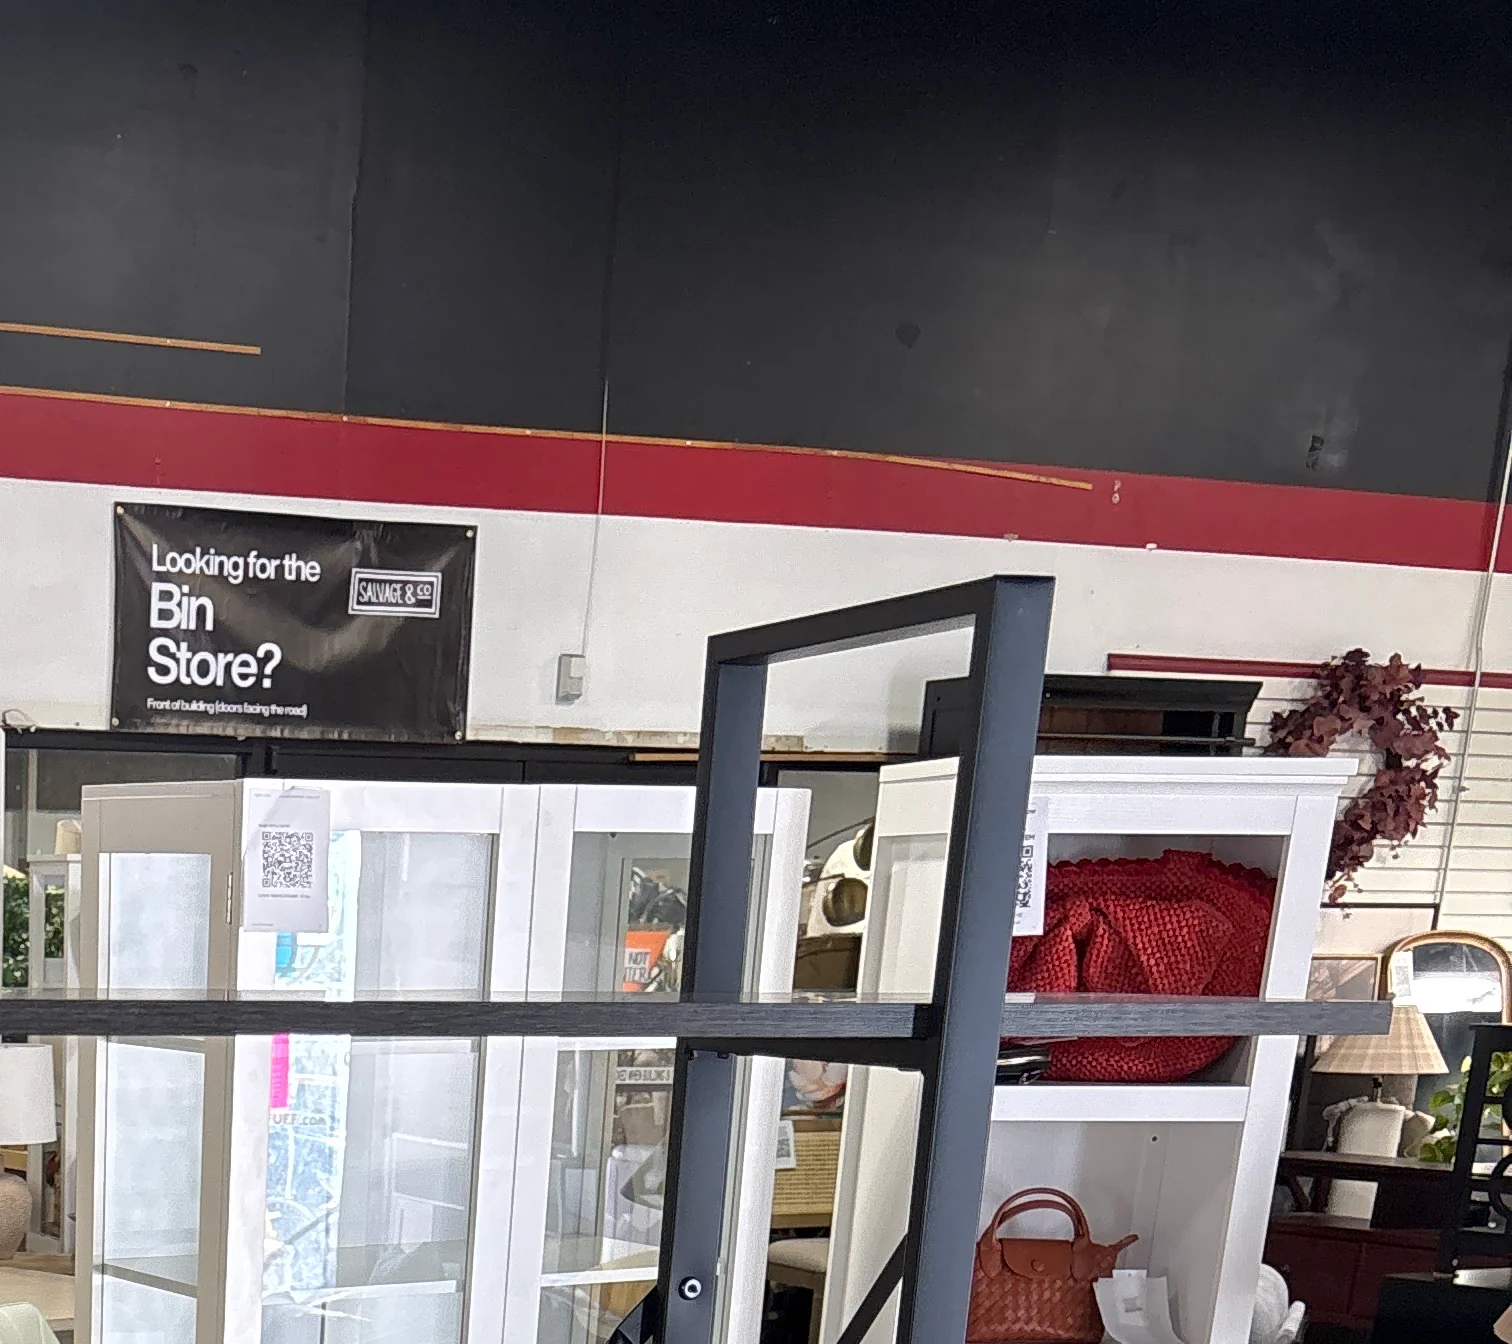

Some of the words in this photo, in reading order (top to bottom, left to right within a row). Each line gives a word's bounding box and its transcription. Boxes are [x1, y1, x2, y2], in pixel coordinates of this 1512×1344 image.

[152, 543, 244, 583] Looking
[247, 550, 282, 580] for
[283, 553, 321, 581] the
[149, 581, 214, 631] Bin
[358, 580, 402, 603] SALVAGE
[404, 584, 415, 604] &
[416, 584, 431, 598] CO
[147, 636, 282, 688] Store?
[146, 697, 170, 709] Front
[171, 698, 180, 710] of
[180, 699, 214, 714] building
[215, 700, 242, 713] (doors
[243, 702, 269, 716] facing
[270, 703, 284, 714] the
[284, 703, 307, 718] road)
